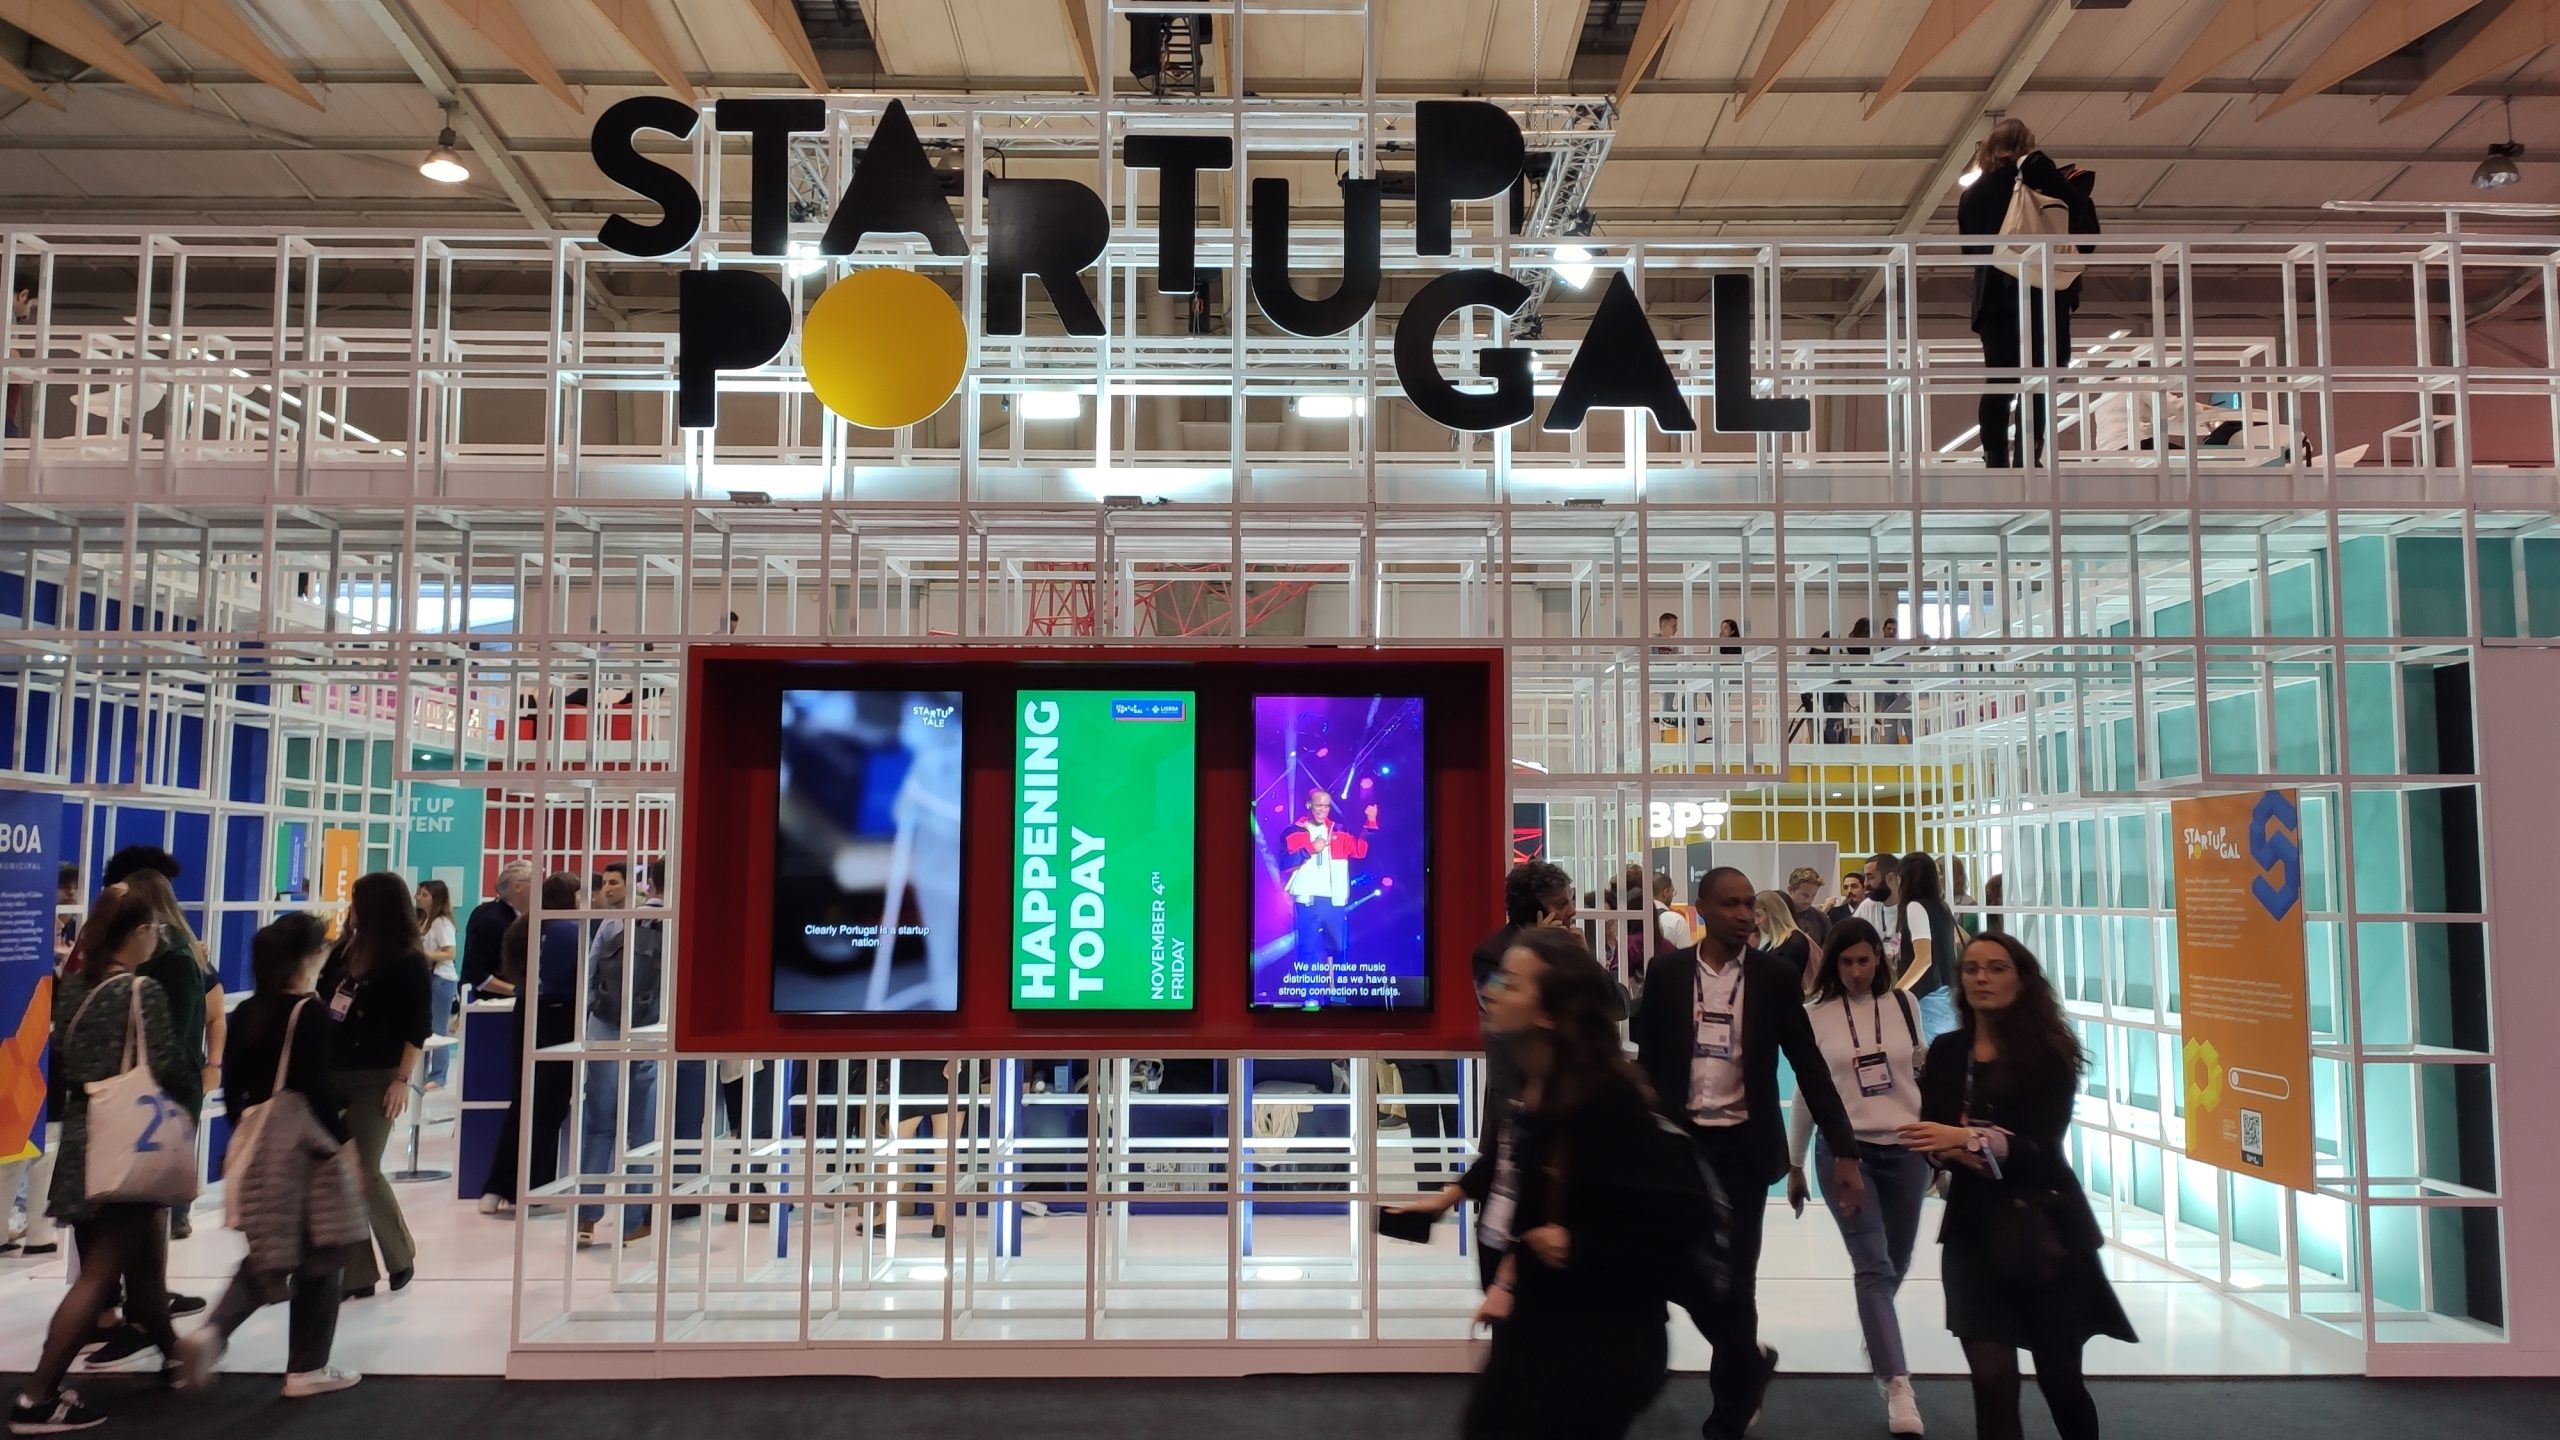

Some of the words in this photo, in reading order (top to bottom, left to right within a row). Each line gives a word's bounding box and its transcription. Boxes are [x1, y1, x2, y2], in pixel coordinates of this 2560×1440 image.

[590, 95, 1526, 338] STARTUP
[912, 706, 955, 719] STARTUP
[922, 717, 945, 728] TALE
[427, 797, 455, 814] UP
[2184, 826, 2226, 850] STARTUP
[1020, 700, 1060, 999] HAPPENING
[1151, 871, 1166, 896] 4TH
[1068, 825, 1106, 1001] TODAY
[804, 924, 837, 936] Clearly
[840, 924, 878, 937] Portugal
[880, 925, 888, 935] is
[898, 925, 930, 936] startup
[1151, 899, 1166, 1001] NOVEMBER
[1171, 937, 1185, 1001] FRIDAY
[1294, 961, 1309, 971] We
[1311, 962, 1330, 972] also
[1332, 962, 1357, 972] make
[1359, 962, 1386, 972] music
[1337, 976, 1348, 984] as
[1350, 976, 1363, 984] we
[1365, 974, 1388, 984] have
[1390, 976, 1396, 984] a
[1278, 987, 1307, 997] strong
[1308, 986, 1357, 996] connection
[1360, 987, 1369, 996] to
